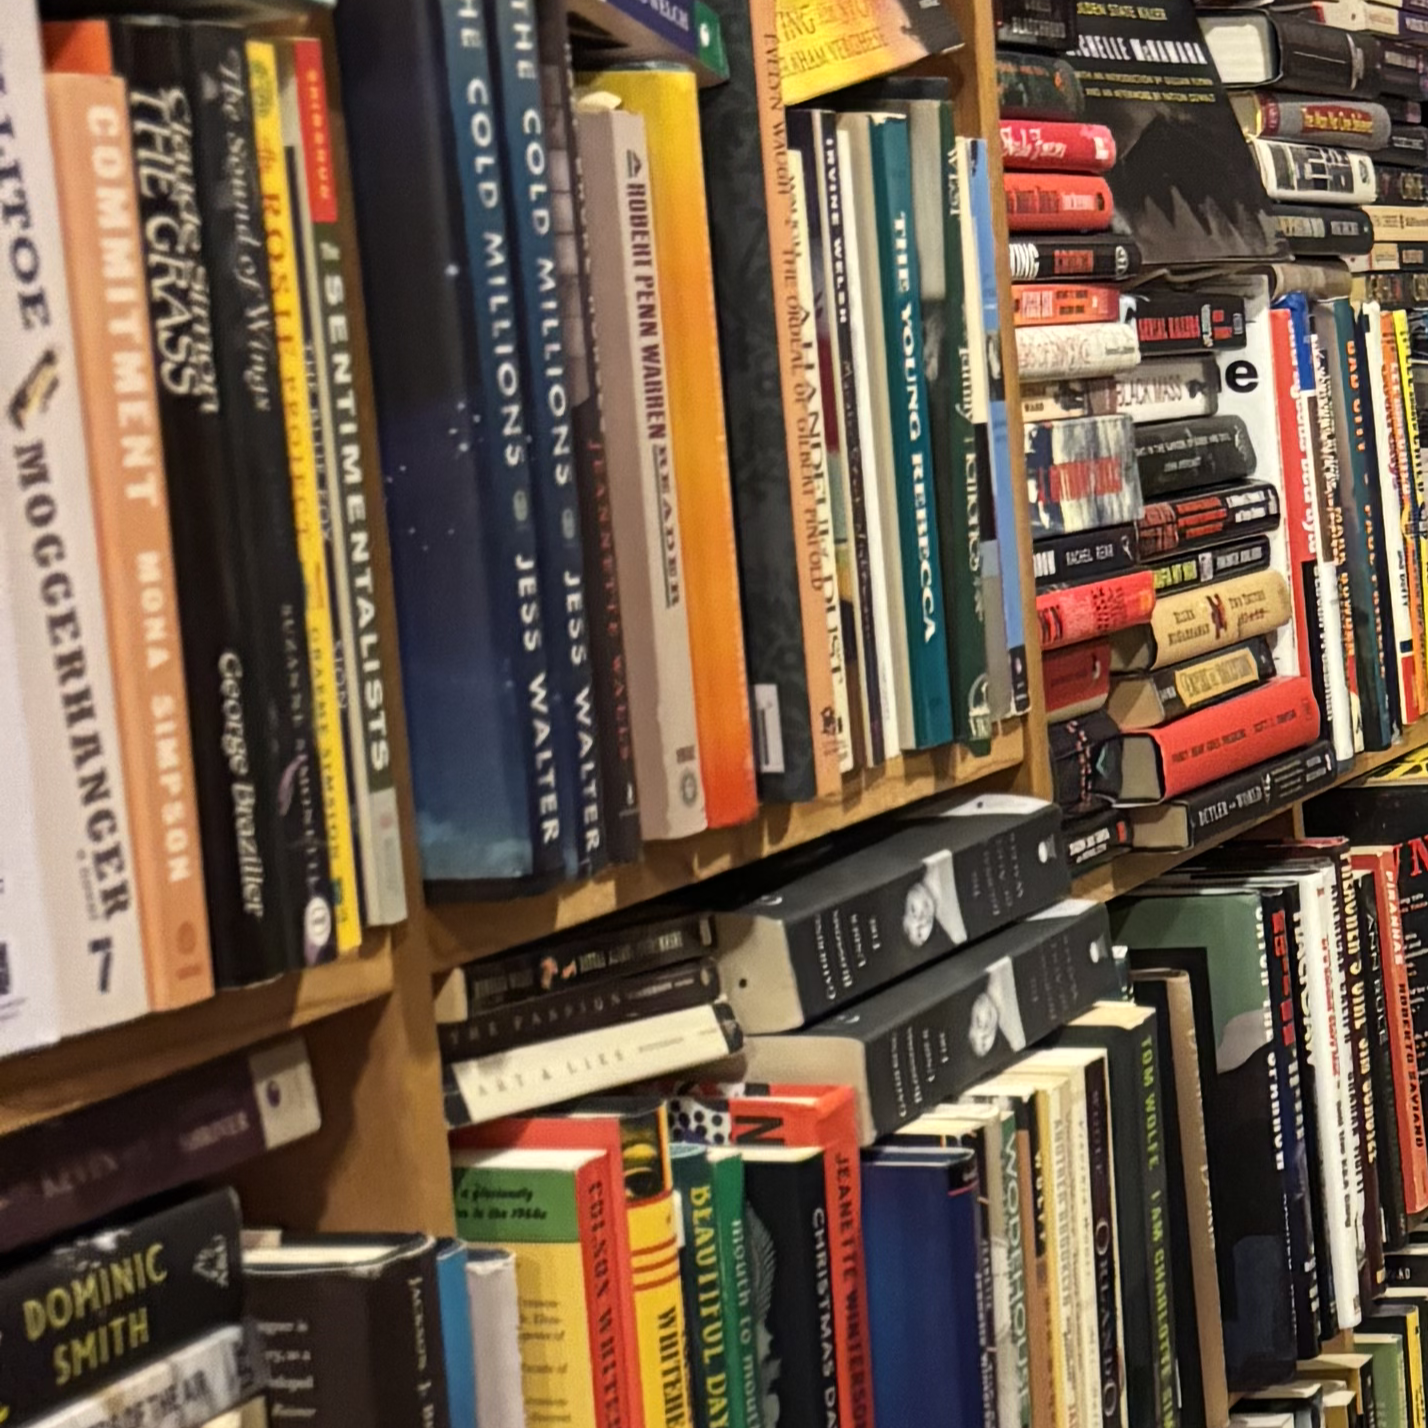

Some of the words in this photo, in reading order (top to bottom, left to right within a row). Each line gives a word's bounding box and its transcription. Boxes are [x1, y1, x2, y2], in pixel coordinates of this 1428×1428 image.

[467, 78, 499, 210] COLD
[86, 104, 160, 509] COMMITMENT
[483, 230, 525, 469] MILLIONS
[135, 551, 171, 670] MONA
[325, 271, 391, 772] SENTIMENTALISTS
[13, 444, 131, 923] MOGGERHANGER
[515, 555, 543, 653] JESS
[529, 673, 561, 846] WALTER
[150, 693, 191, 883] SIMPSON
[22, 1244, 169, 1336] DOMINIC
[52, 1311, 150, 1386] SMITH
[689, 1184, 722, 1362] BEAUTIFUL
